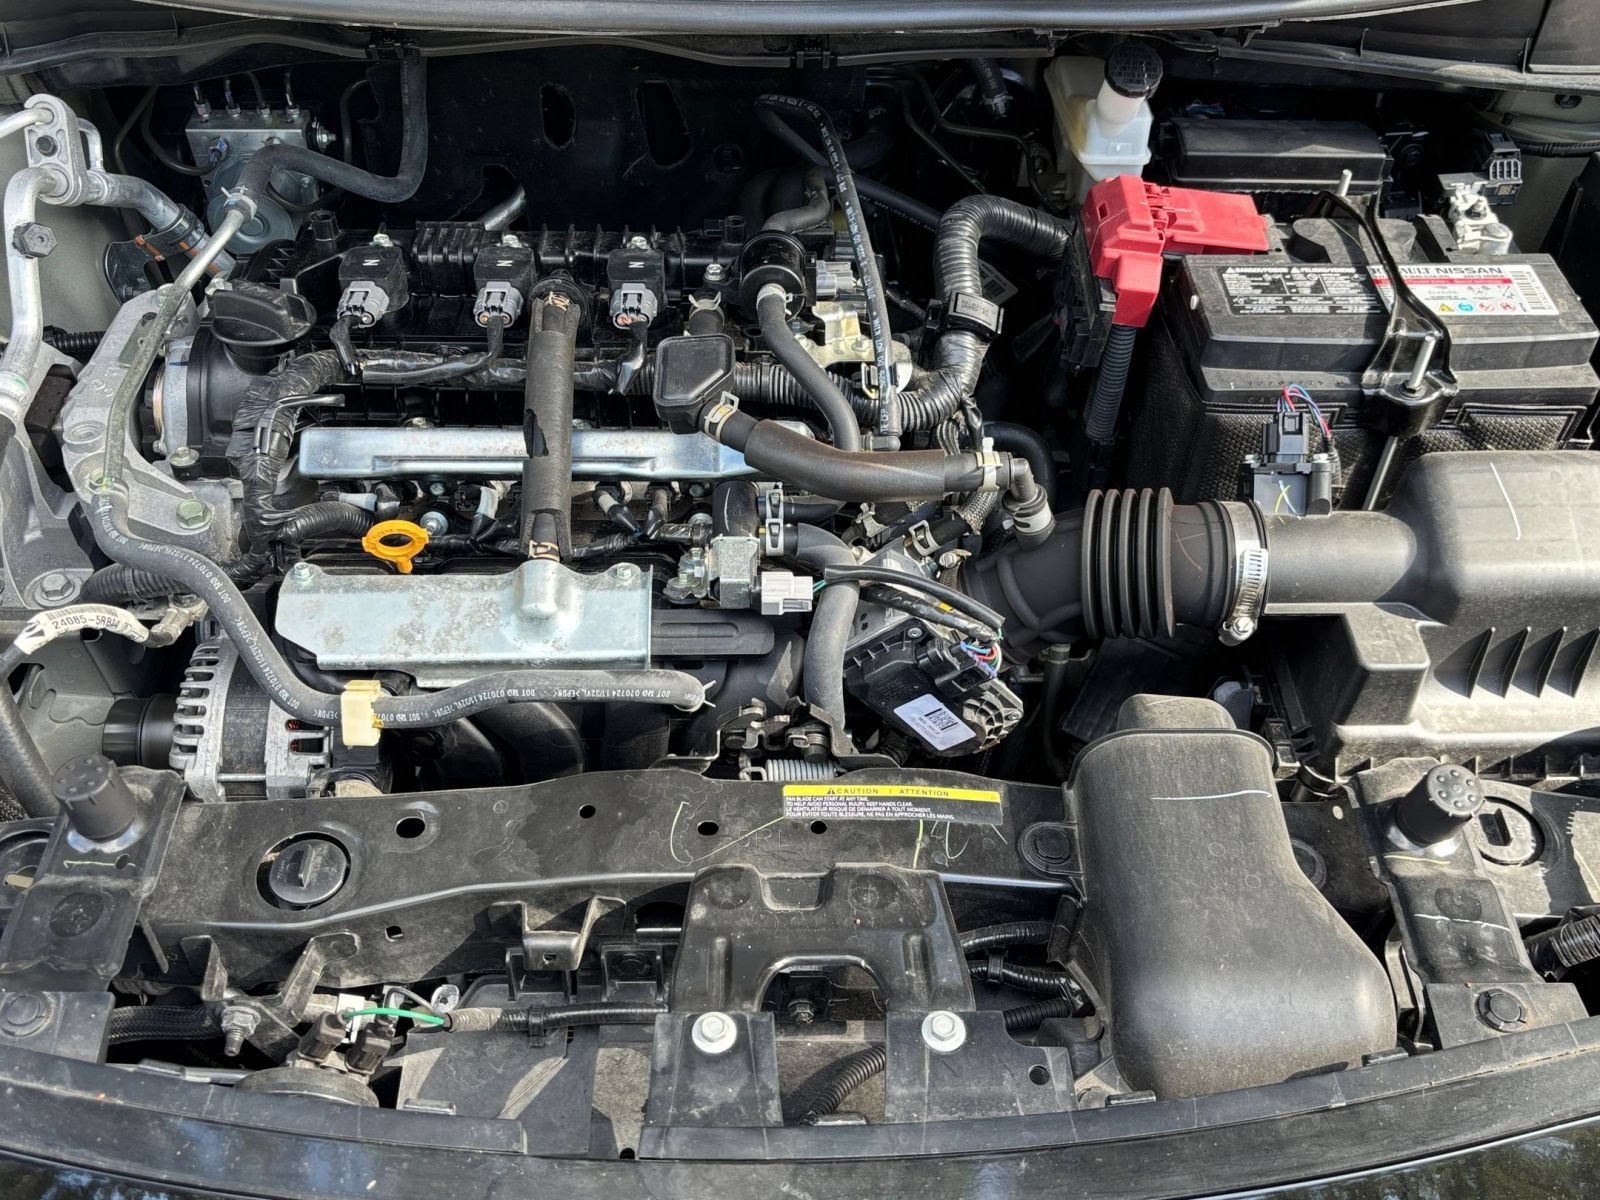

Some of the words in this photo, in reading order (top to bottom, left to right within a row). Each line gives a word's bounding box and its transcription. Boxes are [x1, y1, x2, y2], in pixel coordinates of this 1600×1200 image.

[875, 339, 884, 354] NOT
[218, 589, 232, 604] DOT
[262, 666, 282, 691] 070724
[478, 690, 505, 702] 070724
[522, 689, 536, 697] DOT
[612, 689, 640, 698] 070724
[656, 689, 671, 698] DOT
[287, 697, 300, 709] DOT
[408, 712, 421, 722] DOT
[899, 788, 949, 797] ATTENTION
